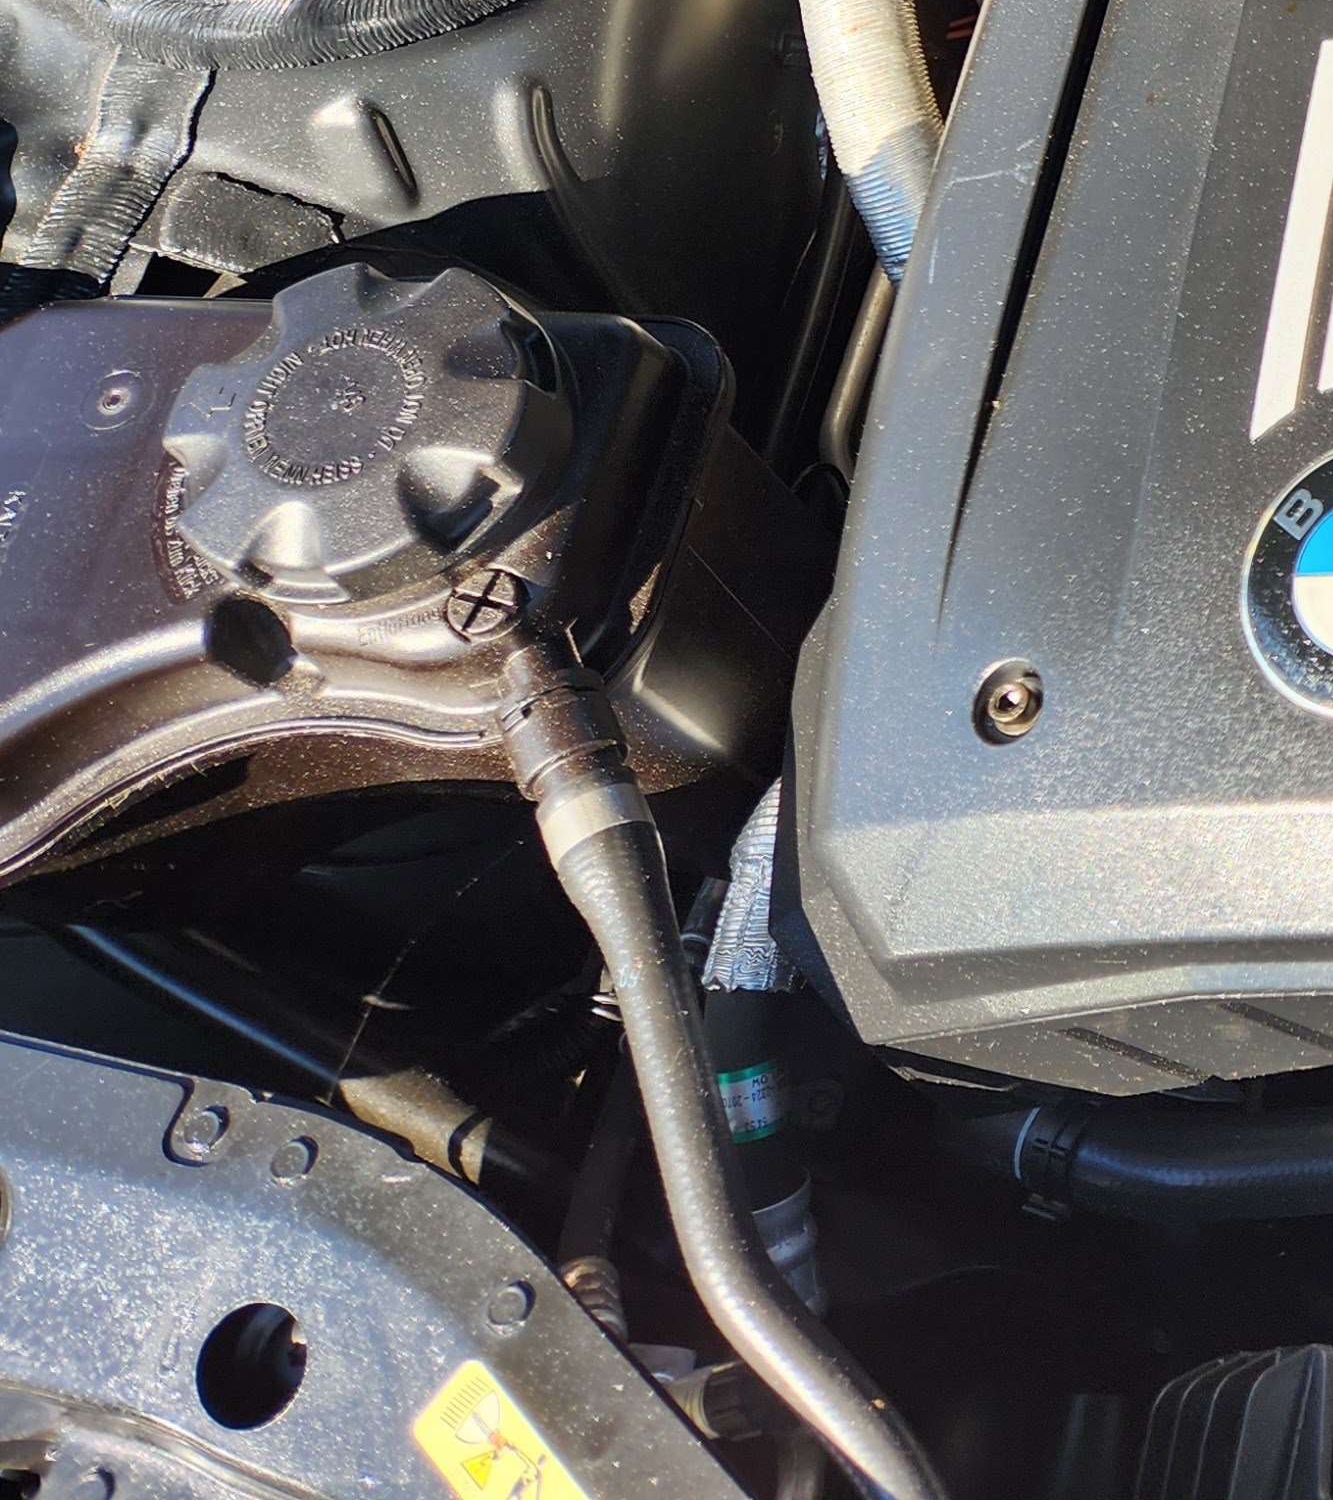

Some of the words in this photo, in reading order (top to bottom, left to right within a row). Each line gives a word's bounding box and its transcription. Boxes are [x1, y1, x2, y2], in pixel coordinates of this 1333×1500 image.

[321, 329, 358, 355] HOT
[257, 352, 304, 396] NICHT
[400, 349, 426, 389] OPEN
[395, 394, 424, 424] NOT
[378, 426, 406, 451] DO
[260, 454, 307, 485] WENN
[310, 455, 363, 485] HEISS
